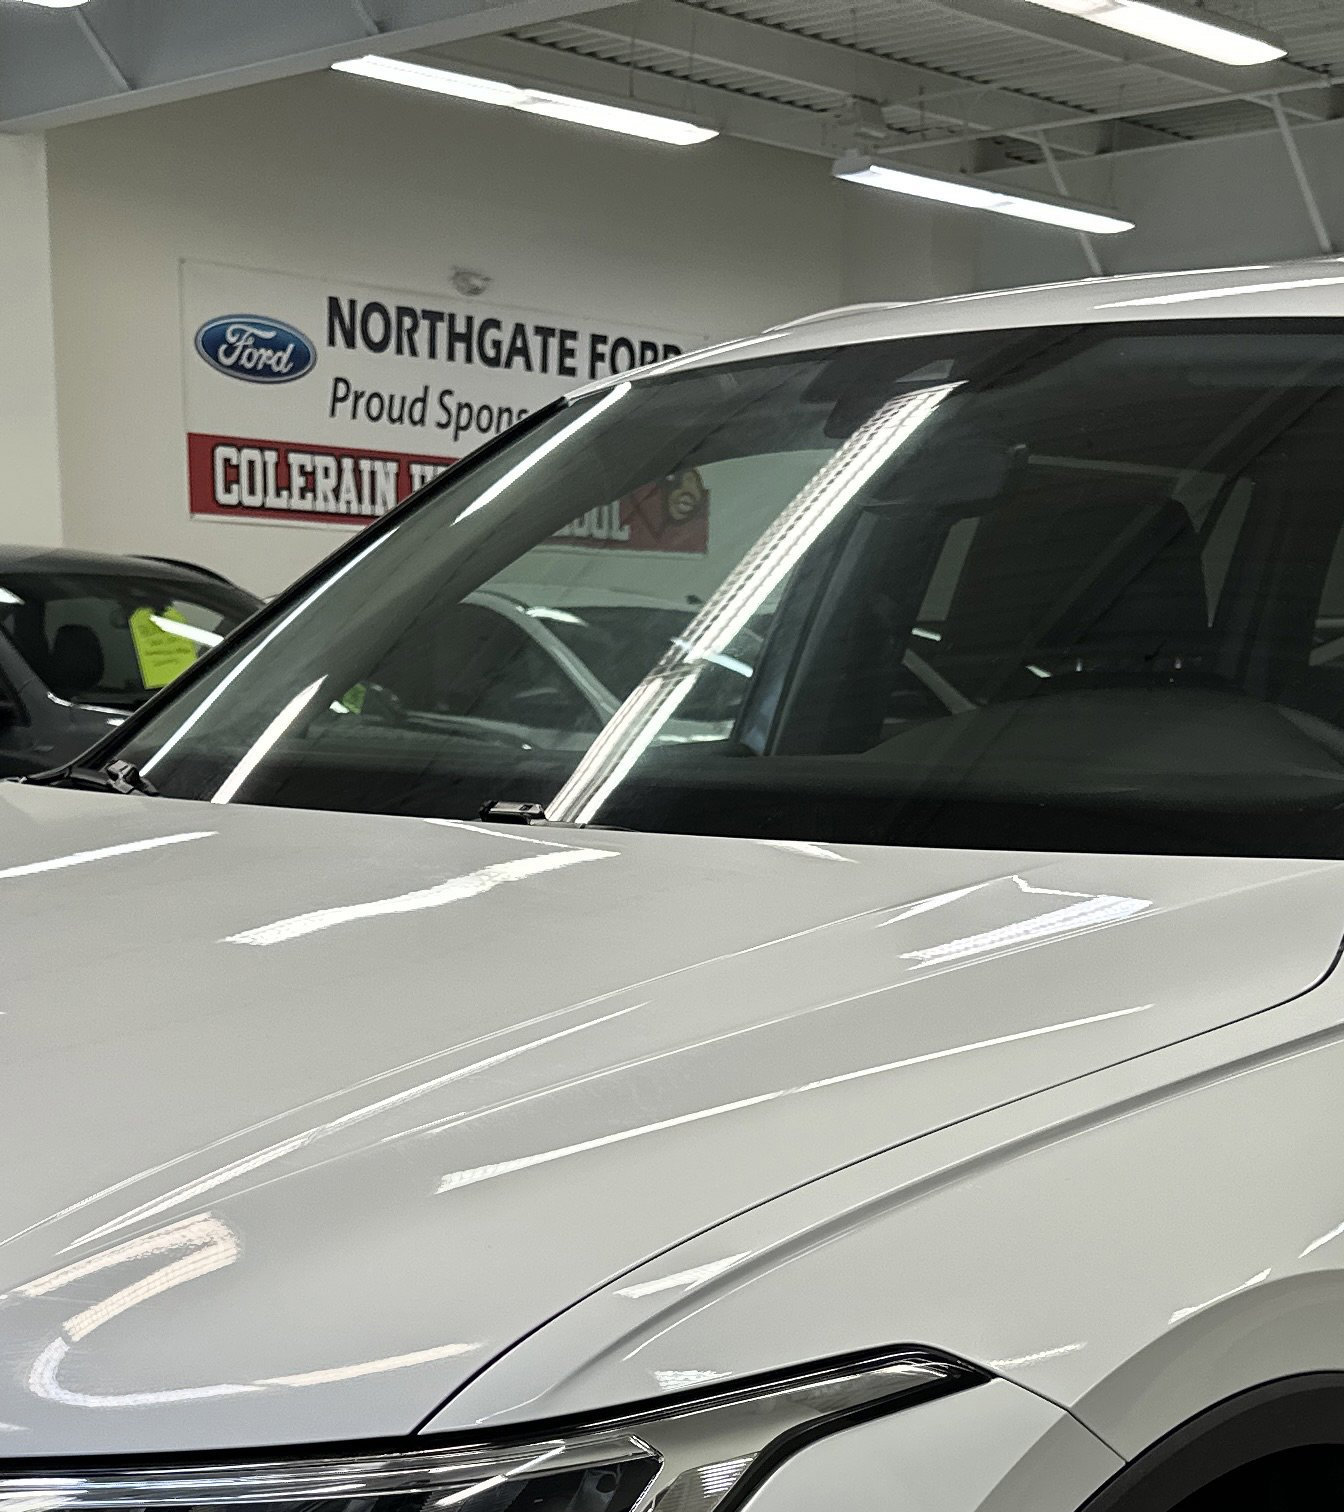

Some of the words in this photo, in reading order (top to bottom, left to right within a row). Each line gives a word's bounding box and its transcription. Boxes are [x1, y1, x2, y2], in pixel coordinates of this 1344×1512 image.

[217, 324, 294, 376] Ford
[326, 296, 577, 378] NORTHGATE
[329, 376, 427, 426] Proud
[213, 445, 401, 516] COLERAIN
